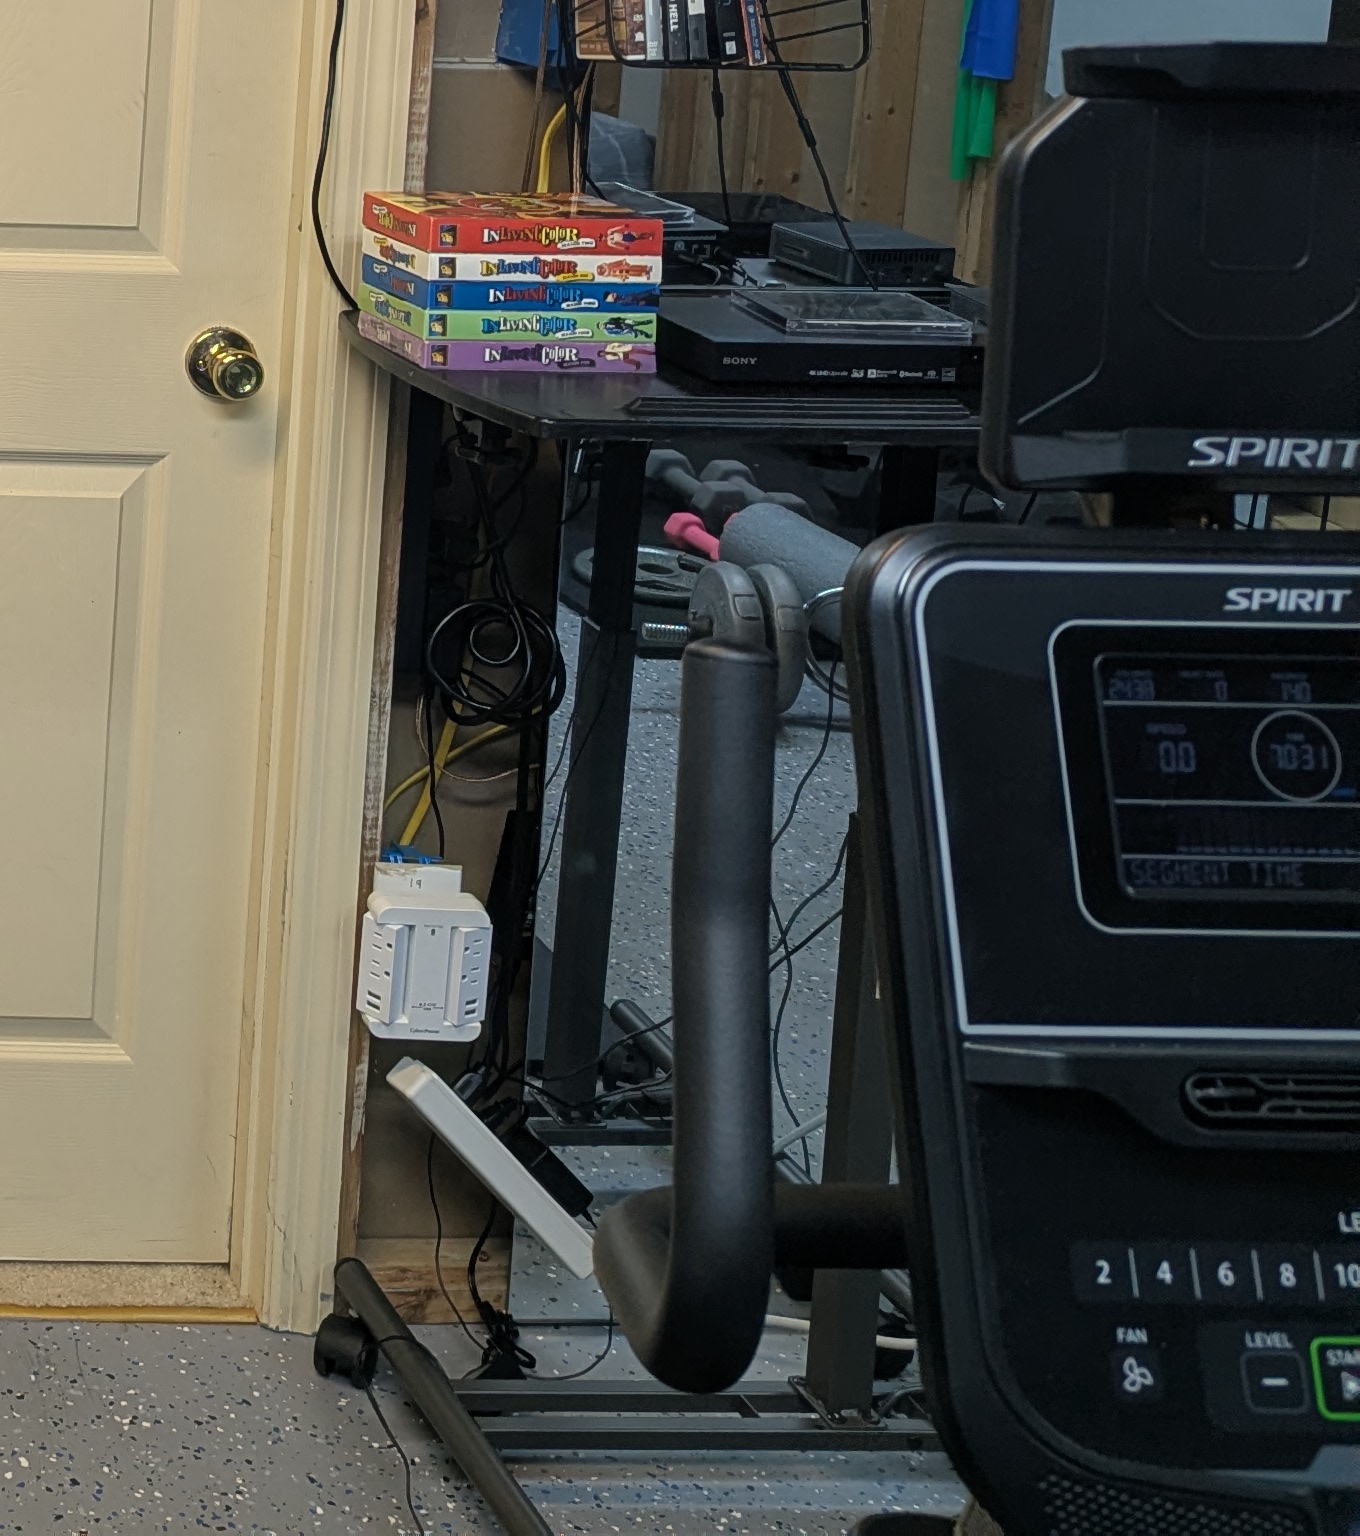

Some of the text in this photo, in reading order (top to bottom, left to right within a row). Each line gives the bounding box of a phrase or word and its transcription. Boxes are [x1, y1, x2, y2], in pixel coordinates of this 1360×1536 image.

[669, 4, 679, 32] HELL
[723, 357, 757, 365] SONY
[1188, 436, 1360, 469] SPIRIT
[1223, 587, 1352, 612] SPIRIT
[1095, 1259, 1360, 1288] 2 4 6 8 10
[1116, 1327, 1295, 1349] FAN LEVEL
